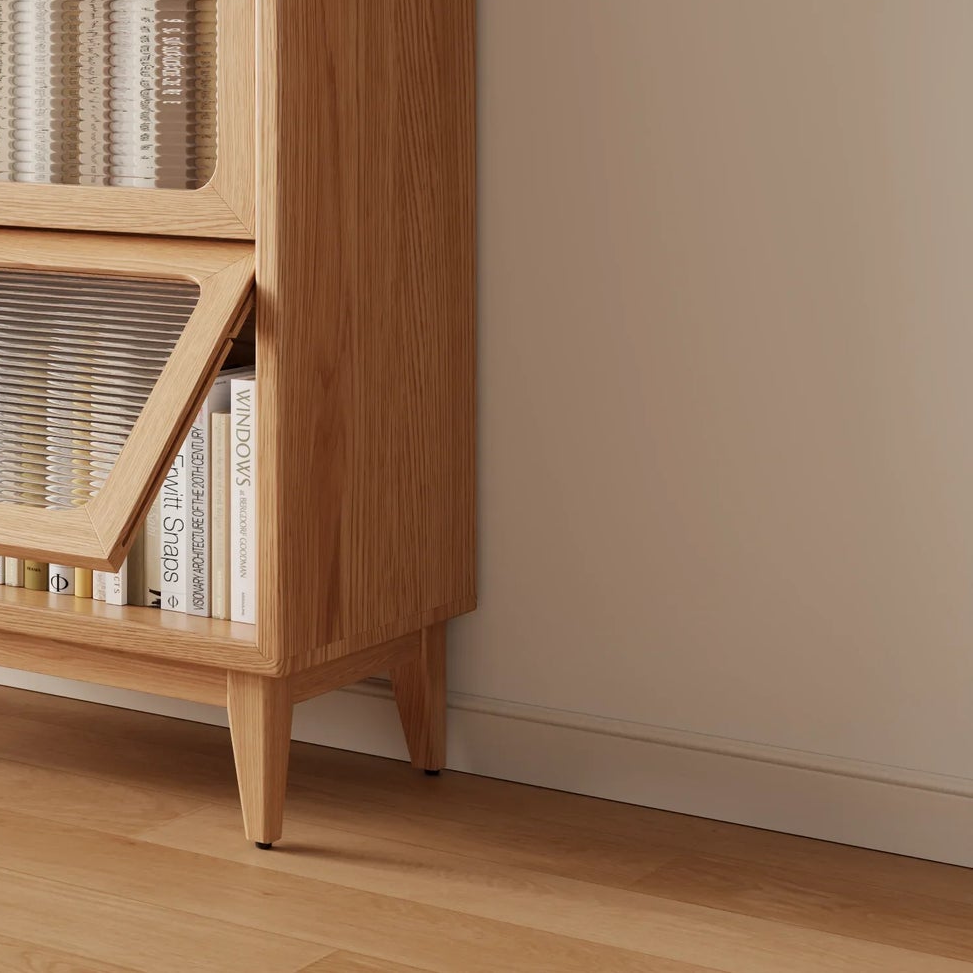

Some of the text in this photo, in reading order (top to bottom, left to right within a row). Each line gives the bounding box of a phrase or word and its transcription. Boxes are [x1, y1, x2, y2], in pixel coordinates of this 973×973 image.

[235, 388, 251, 487] WINDOWS
[161, 516, 185, 583] Snaps
[191, 426, 205, 611] VISIONARY ARCHITECTURE OF THE 20TH CENTURY
[239, 538, 248, 579] GOODMAN
